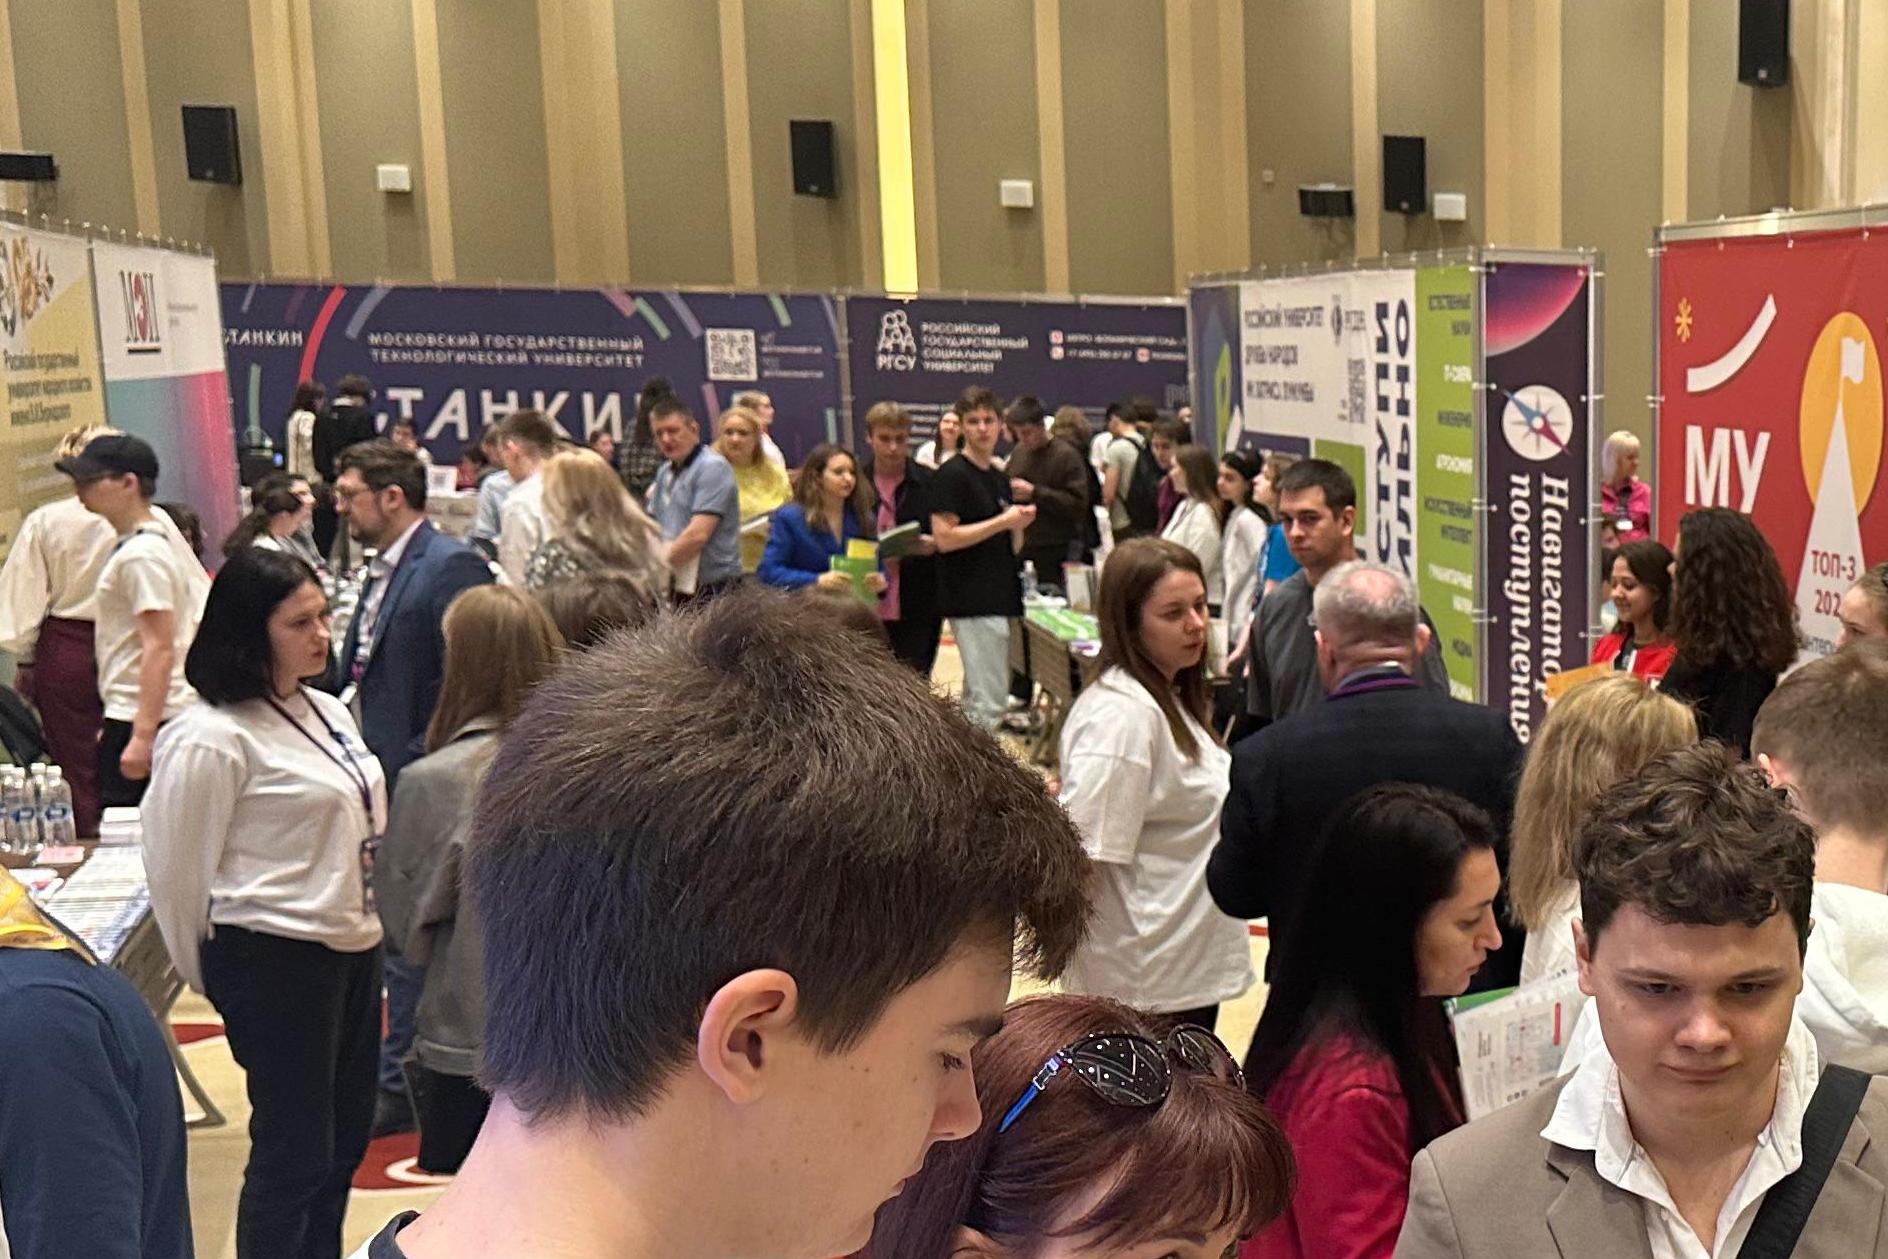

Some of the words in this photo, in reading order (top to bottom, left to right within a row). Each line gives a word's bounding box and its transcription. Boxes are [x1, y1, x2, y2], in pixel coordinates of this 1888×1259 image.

[367, 332, 480, 347] МОСКОВСКИЙ
[483, 334, 644, 350] ГОСУДАРСТВЕННЫЙ
[372, 349, 529, 365] ТЕХНОЛОГИЧЕСКИЙ
[533, 354, 644, 368] УНИВЕРСИТЕТ
[370, 386, 642, 442] ТАНКИ
[1685, 425, 1770, 515] МУ
[1812, 550, 1856, 581] ТОП-3
